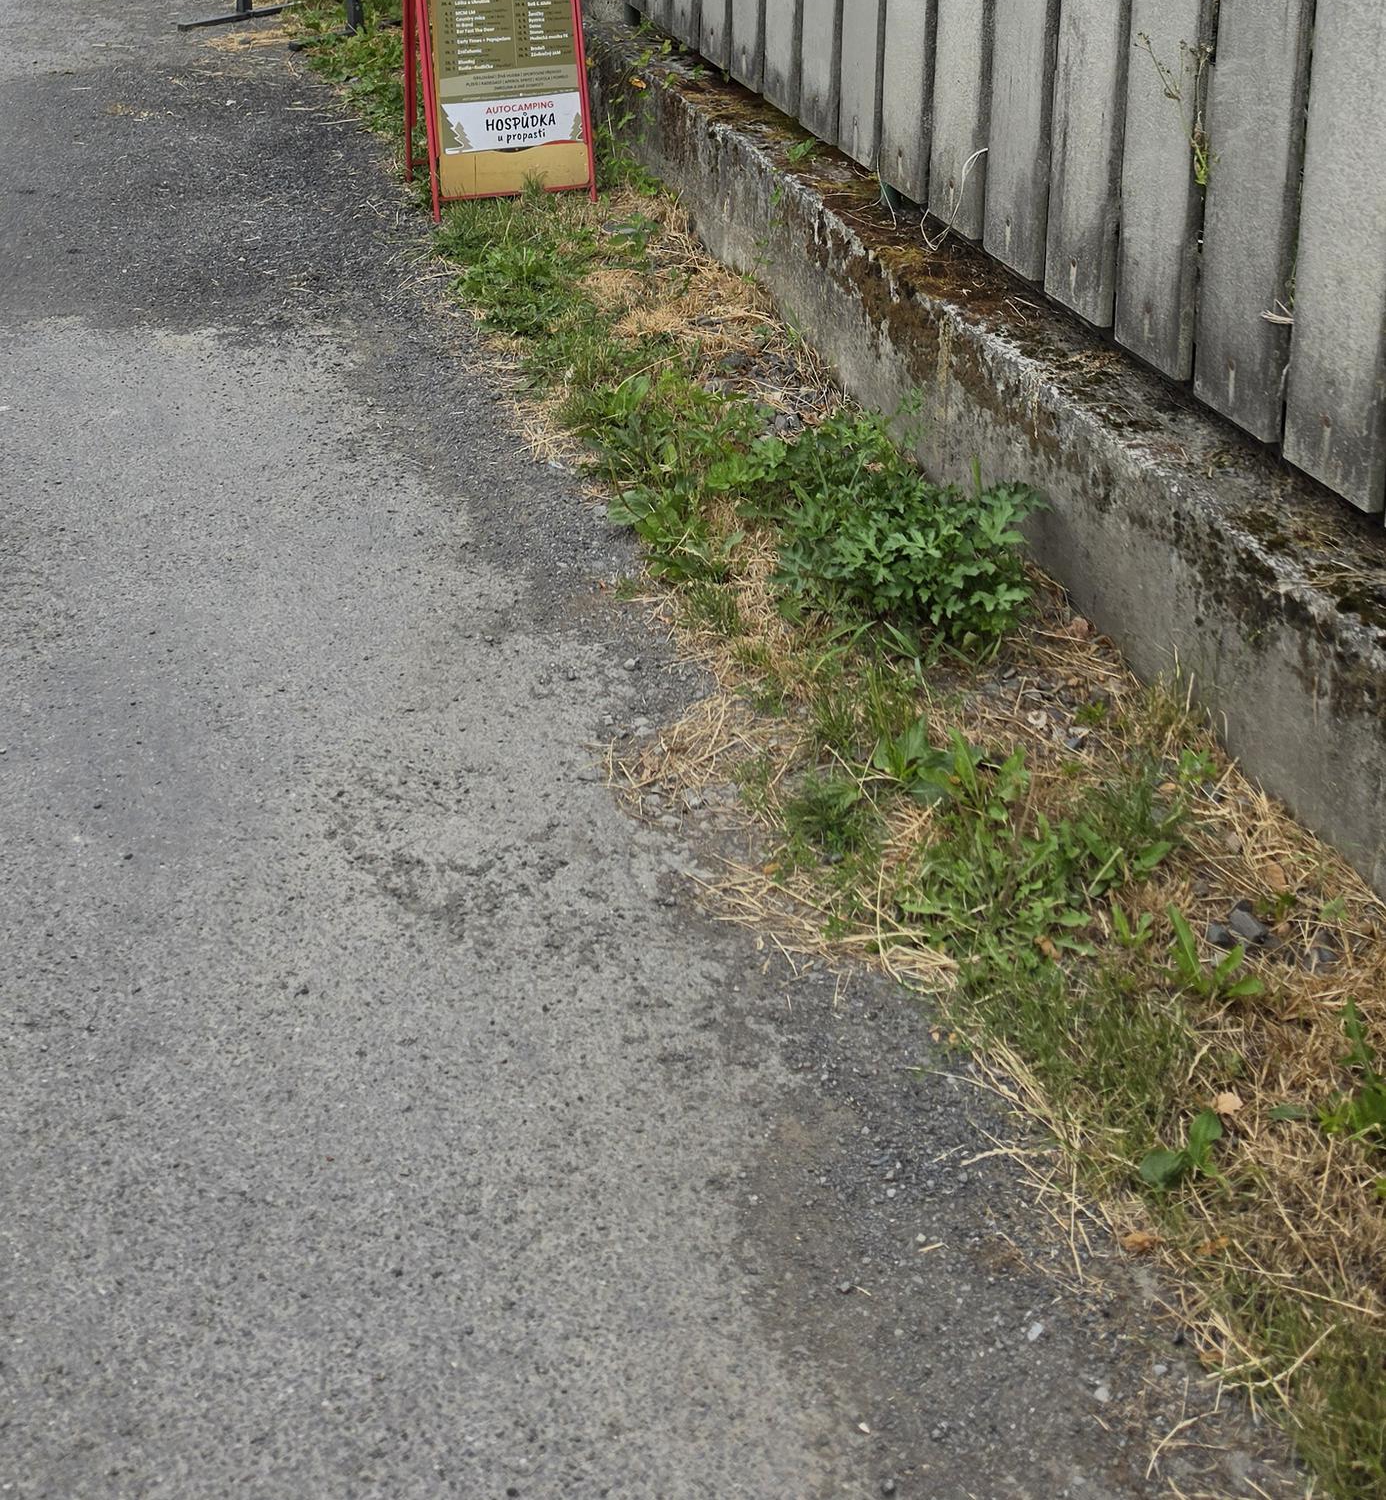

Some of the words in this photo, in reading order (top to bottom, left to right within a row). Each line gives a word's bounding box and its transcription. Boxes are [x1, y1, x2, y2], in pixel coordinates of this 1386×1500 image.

[486, 101, 554, 114] AUTOCAMPING
[486, 112, 556, 131] HOSPŮDKA
[507, 129, 546, 143] propasti
